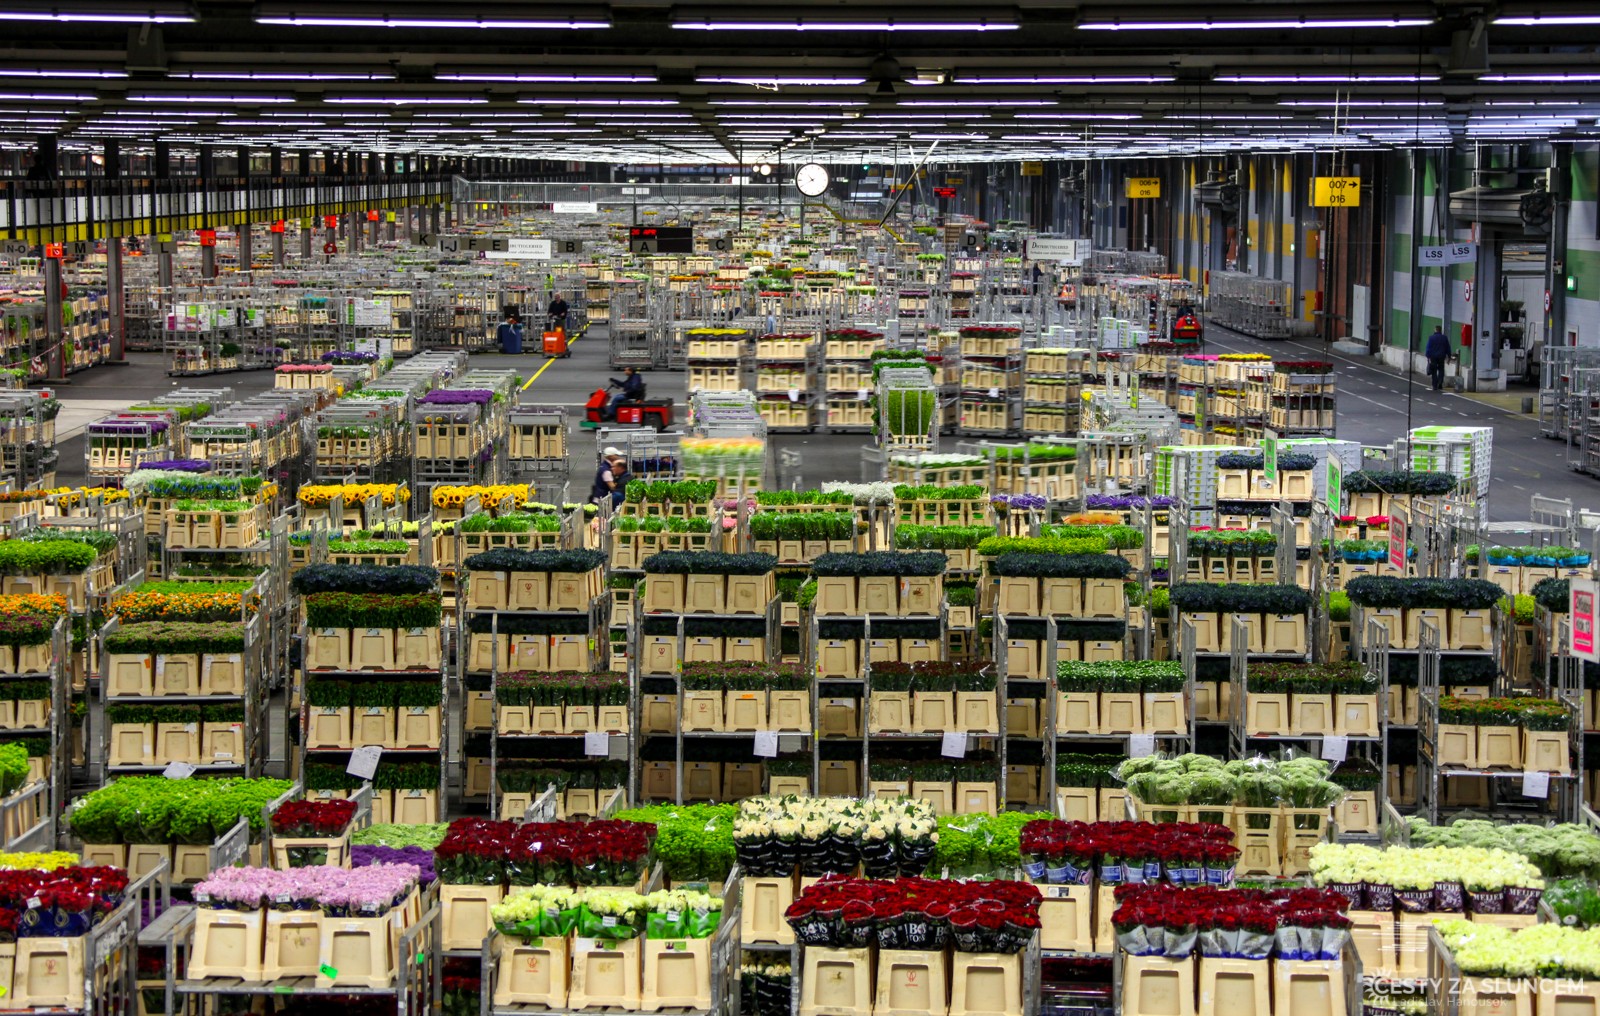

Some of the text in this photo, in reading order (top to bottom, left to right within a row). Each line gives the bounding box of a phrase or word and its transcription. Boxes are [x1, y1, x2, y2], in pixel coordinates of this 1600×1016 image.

[1329, 181, 1347, 189] 007
[1330, 195, 1346, 203] 016
[419, 234, 429, 246] K
[469, 239, 477, 250] F
[493, 240, 501, 251] E
[715, 240, 726, 251] C
[967, 235, 976, 246] D
[7, 245, 26, 254] N-O
[75, 243, 86, 254] M
[161, 243, 169, 254] L
[565, 242, 575, 253] B
[640, 241, 650, 252] A
[1452, 246, 1470, 256] LSS
[1425, 250, 1443, 258] LSS
[1369, 885, 1393, 894] MEIJE
[1436, 883, 1461, 891] MEIJE
